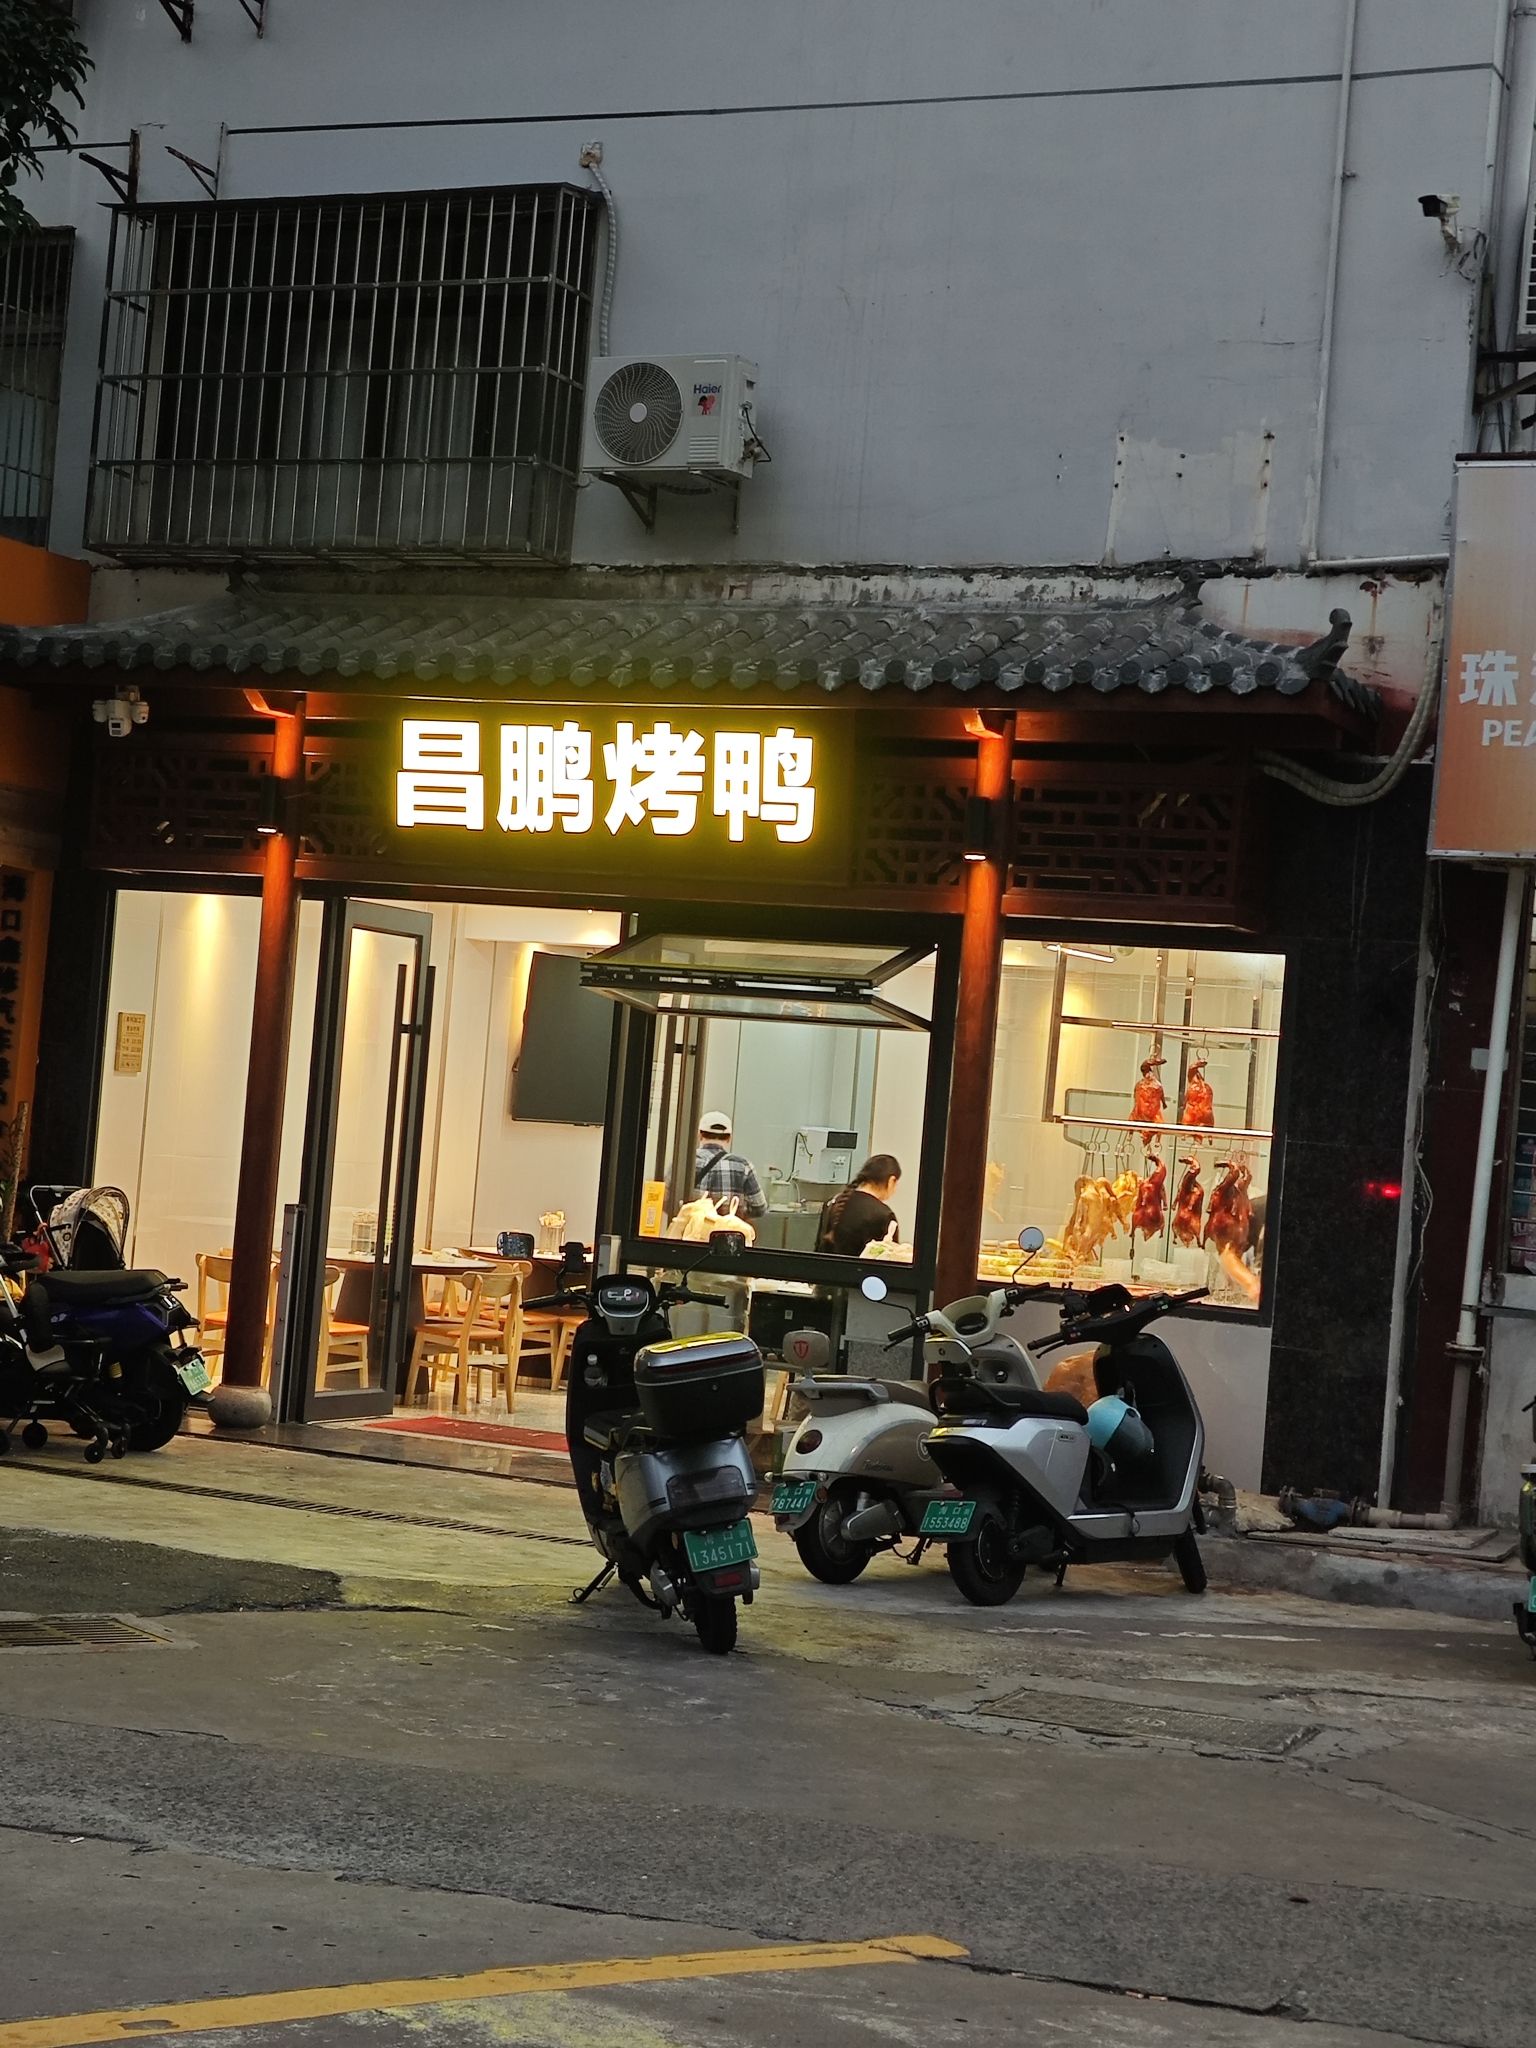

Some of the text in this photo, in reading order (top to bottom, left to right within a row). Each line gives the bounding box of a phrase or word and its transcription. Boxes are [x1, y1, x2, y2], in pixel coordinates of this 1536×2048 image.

[693, 383, 722, 394] Haier
[1459, 650, 1536, 706] 珠
[396, 719, 817, 843] 昌鹏烤鸭
[692, 1541, 753, 1568] 1345171
